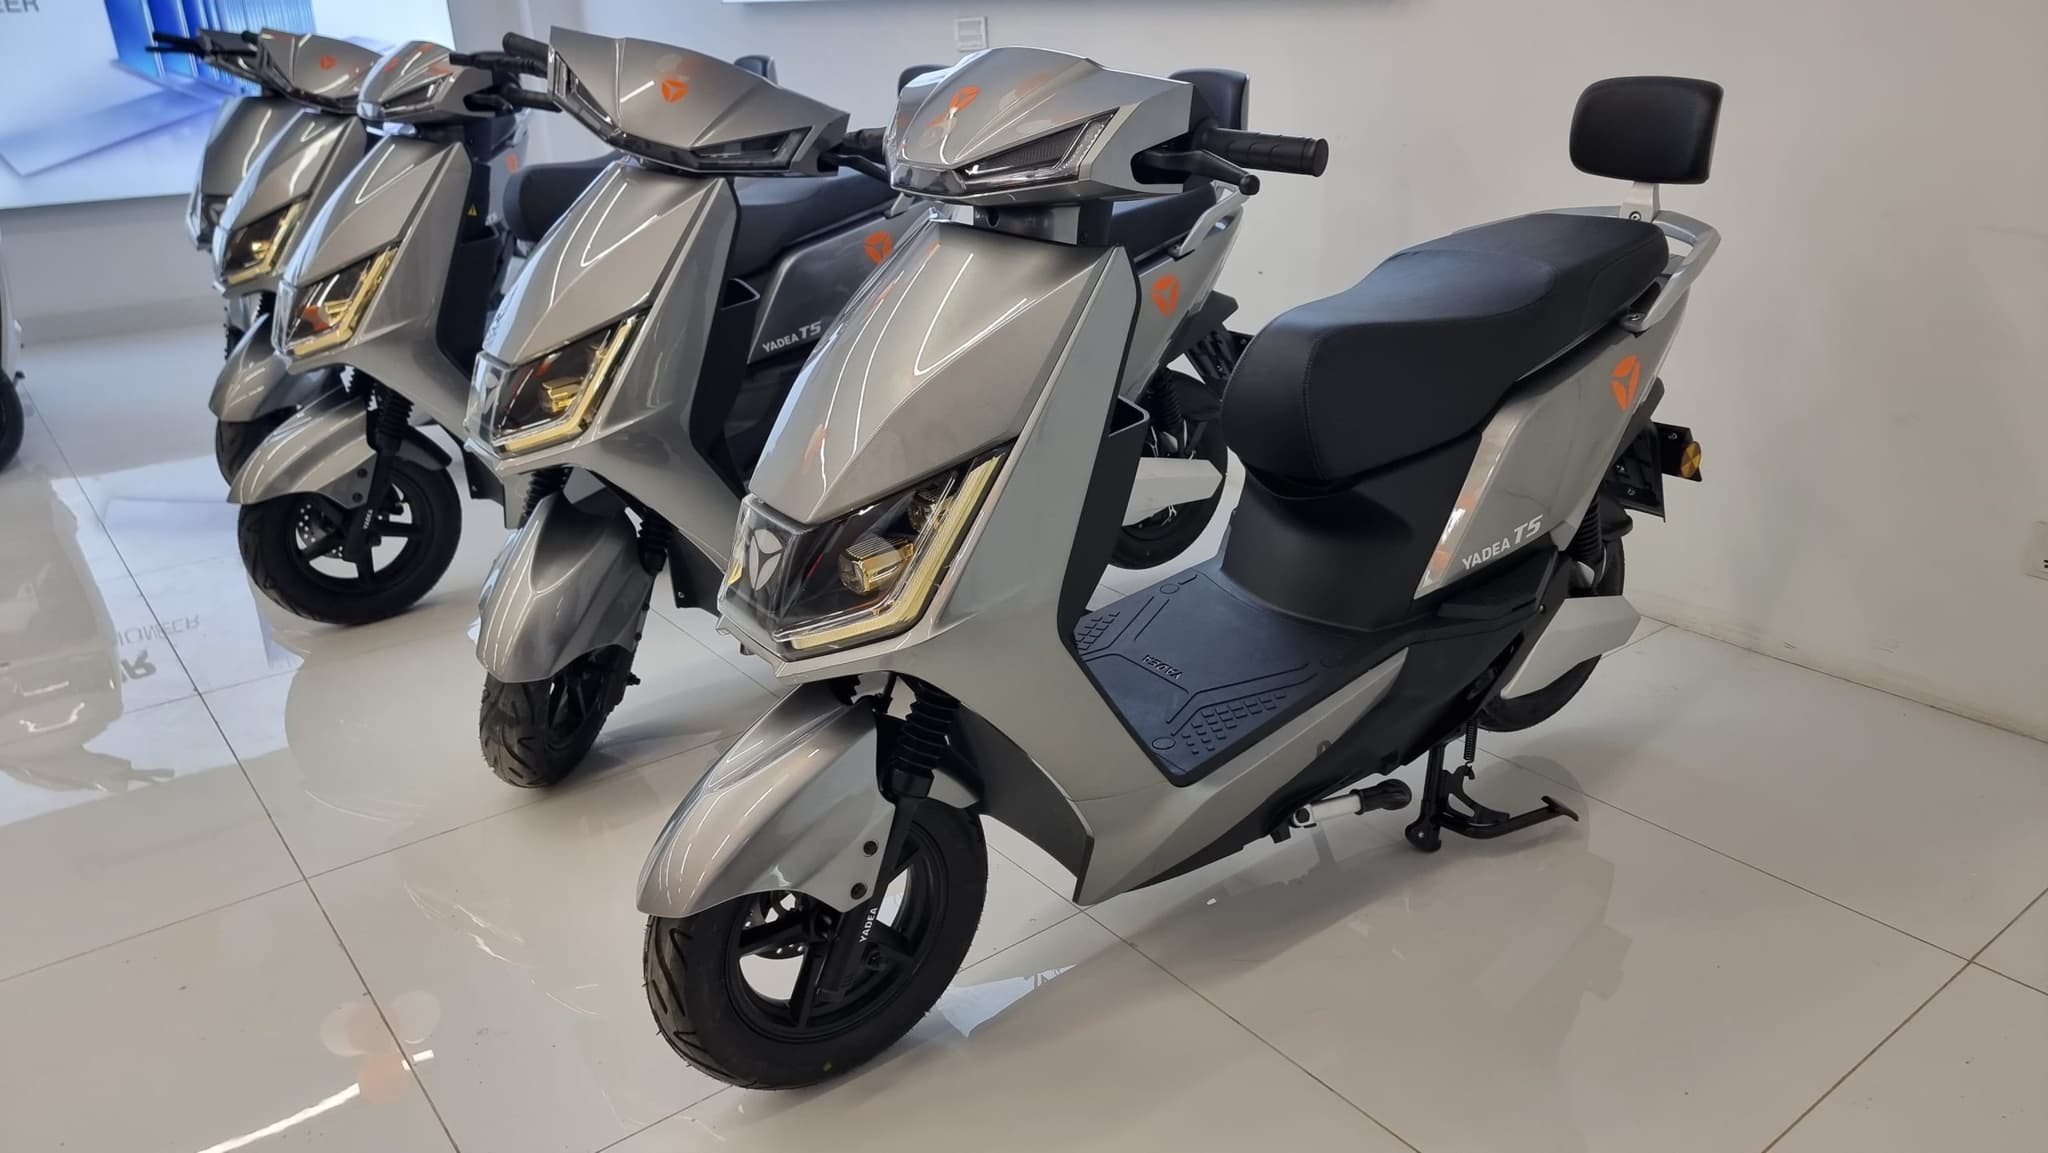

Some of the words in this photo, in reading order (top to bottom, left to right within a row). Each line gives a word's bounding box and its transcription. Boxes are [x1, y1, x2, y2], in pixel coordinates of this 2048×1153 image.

[0, 0, 40, 13] ER
[762, 333, 800, 352] YADEA
[1462, 537, 1511, 570] YADEA
[1142, 654, 1183, 680] YADEA
[859, 907, 878, 943] YADEA
